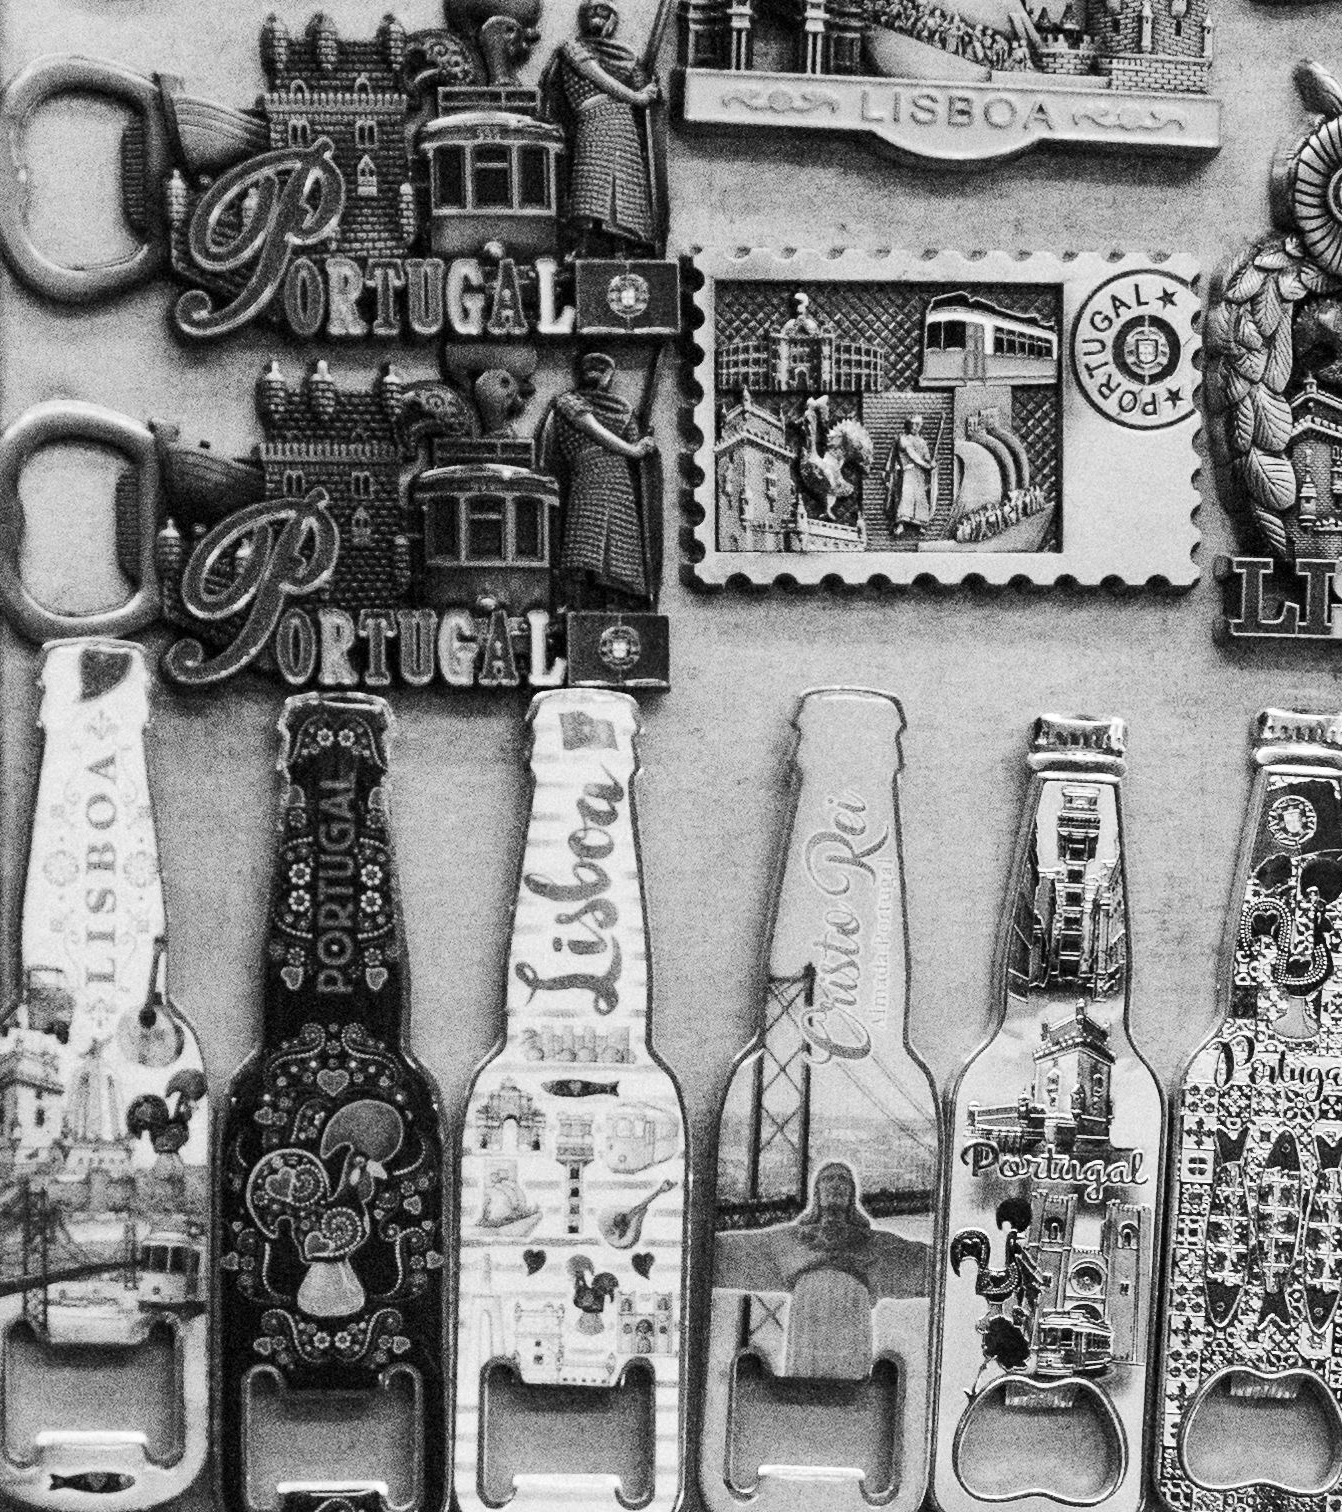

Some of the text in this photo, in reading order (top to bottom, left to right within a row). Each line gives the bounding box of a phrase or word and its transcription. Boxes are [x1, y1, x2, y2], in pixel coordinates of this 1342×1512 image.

[859, 96, 1057, 131] LISBOA
[1080, 284, 1160, 416] PORTUGAL
[85, 753, 119, 990] LISBOA
[316, 769, 355, 994] PORTUGAL
[515, 763, 626, 1016] Lisboa
[799, 794, 890, 1065] Cristo Rei
[960, 1140, 1150, 1203] Portugal
